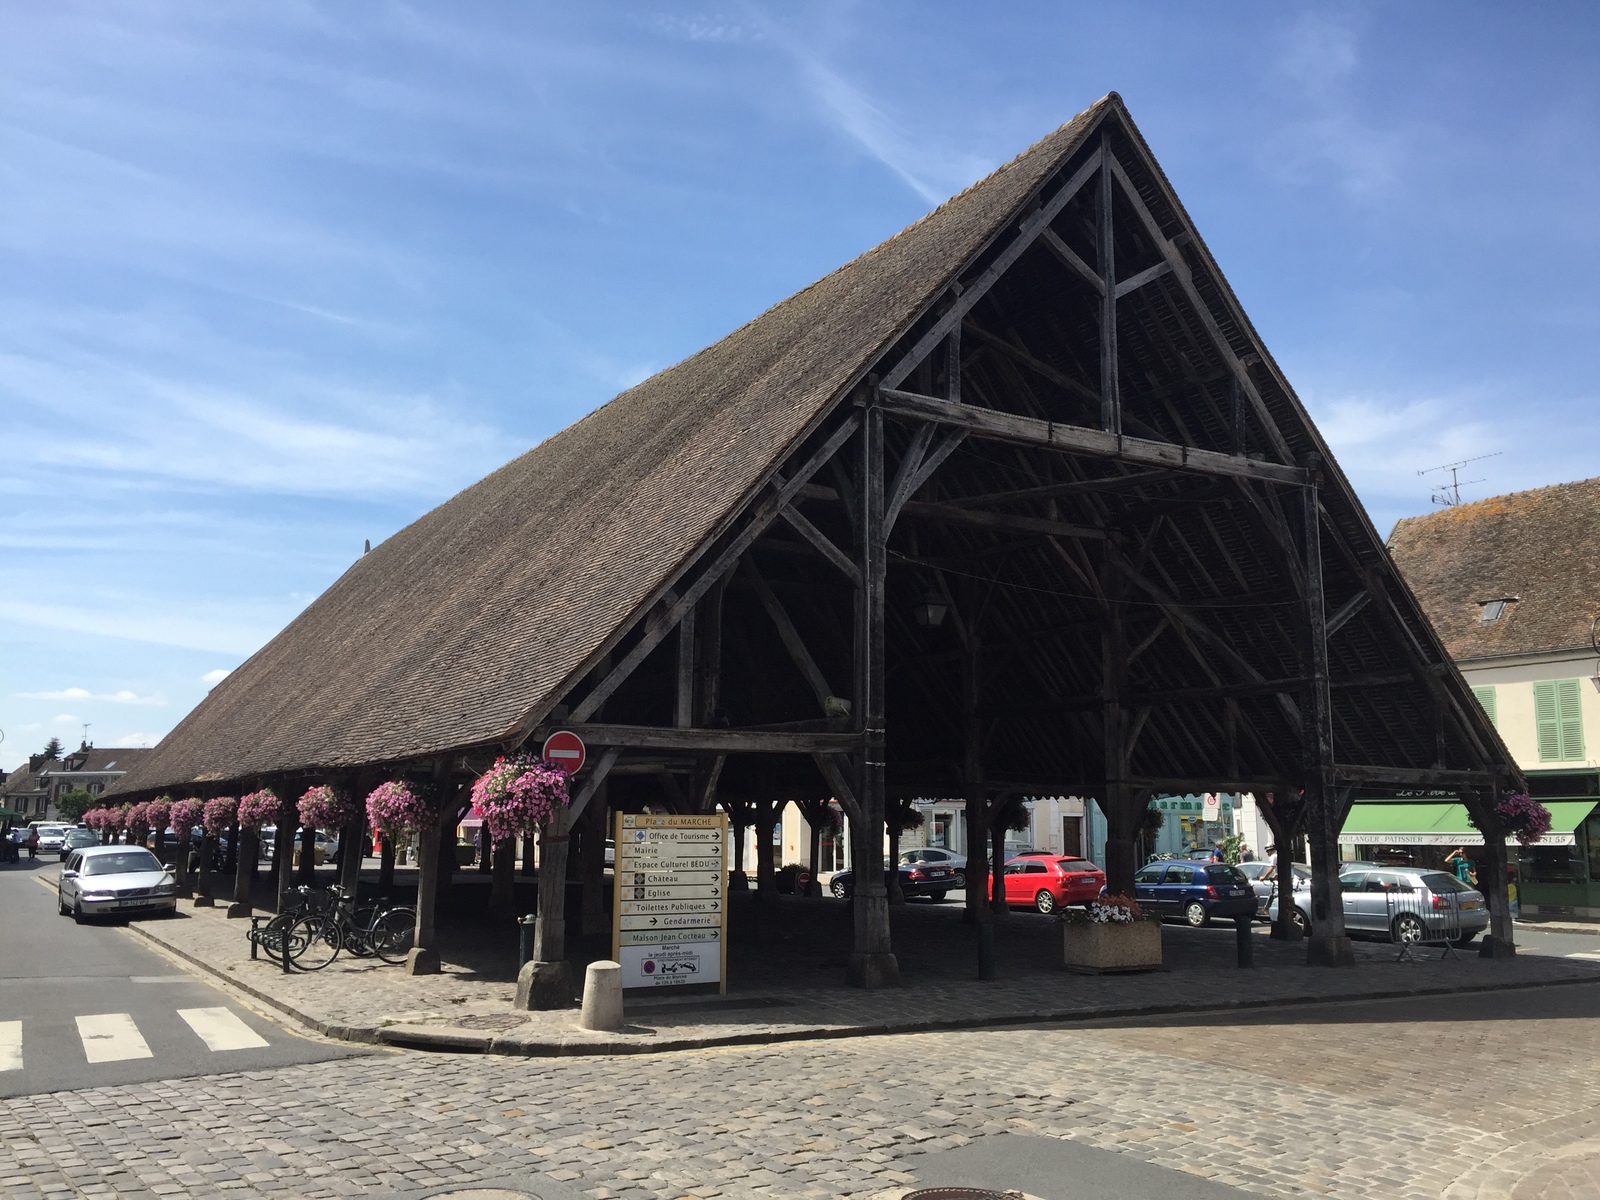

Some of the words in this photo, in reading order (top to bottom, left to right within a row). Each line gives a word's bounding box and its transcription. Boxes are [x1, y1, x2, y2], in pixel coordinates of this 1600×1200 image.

[645, 818, 666, 826] Plae
[649, 832, 669, 840] Office
[670, 832, 678, 840] de
[680, 832, 710, 840] Tourisme
[1554, 836, 1566, 844] 55
[634, 861, 658, 870] Espace
[660, 860, 689, 868] Culturel
[671, 903, 706, 911] Publiques
[663, 917, 711, 925] Gendarmerie
[633, 934, 658, 942] Maison
[660, 934, 676, 942] Jean
[678, 932, 706, 940] Cocteau
[653, 951, 667, 959] jeudi
[667, 950, 693, 959] après-midi
